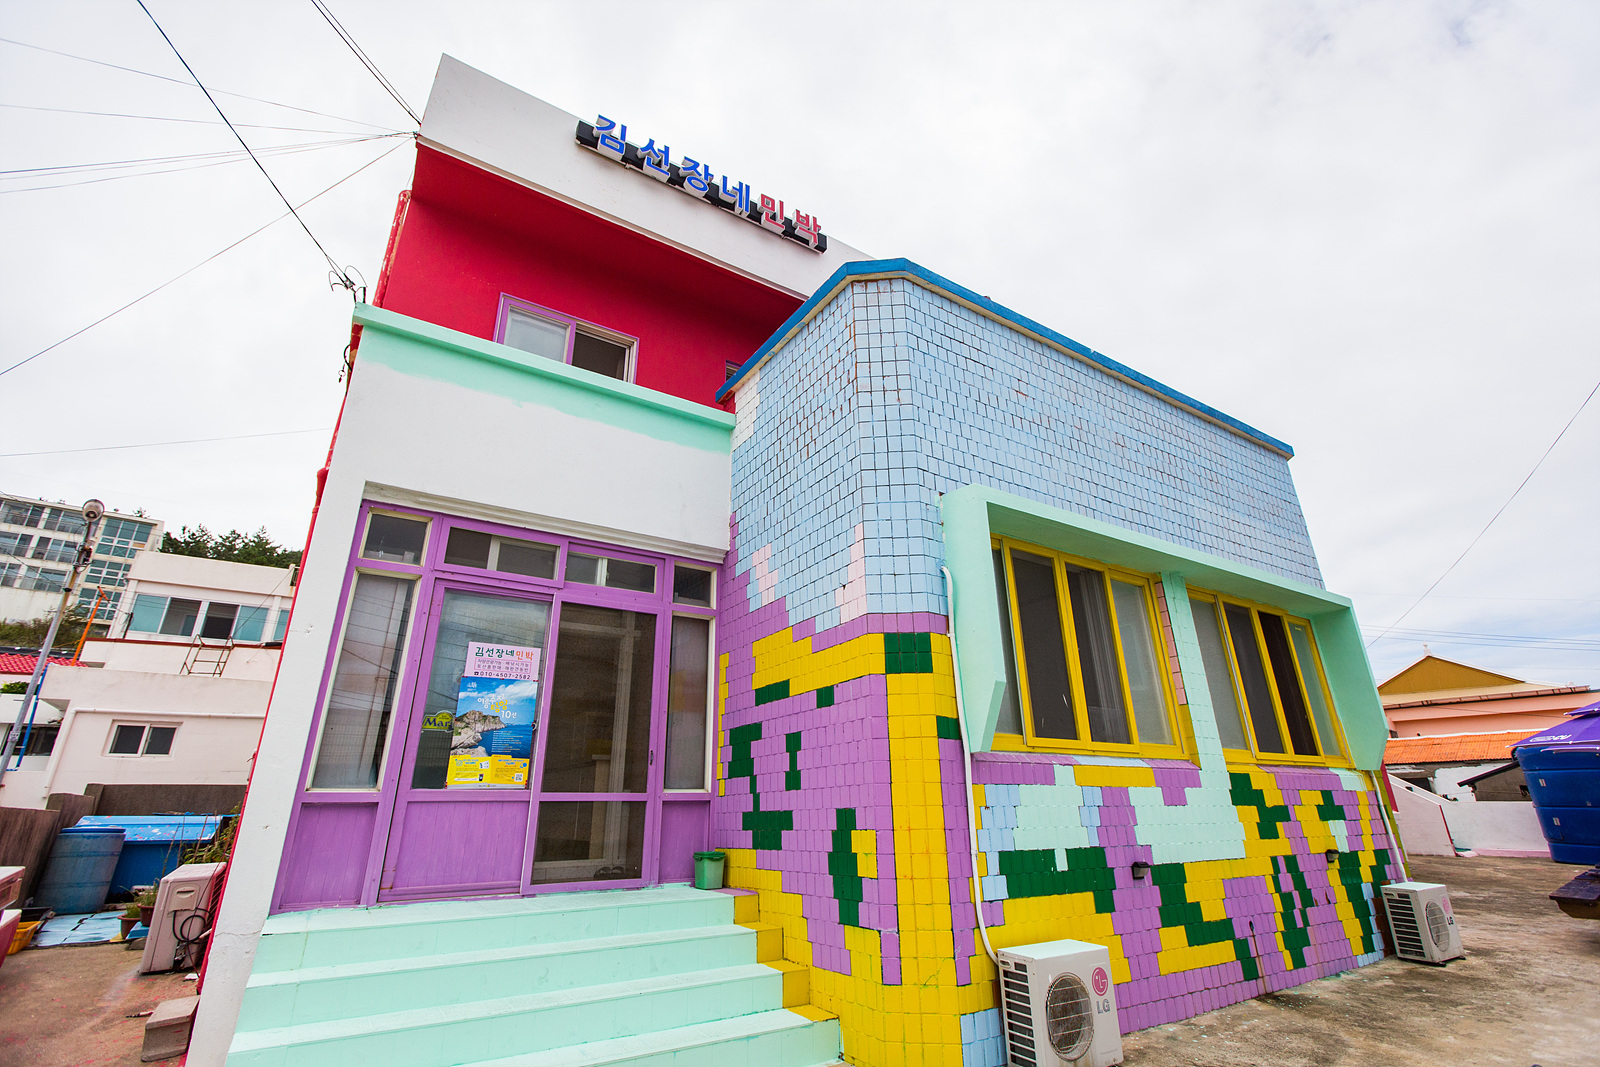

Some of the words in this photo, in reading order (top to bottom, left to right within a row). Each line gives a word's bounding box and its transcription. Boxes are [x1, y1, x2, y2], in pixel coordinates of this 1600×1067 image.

[593, 114, 750, 216] 김선장네
[757, 192, 822, 247] 민박
[475, 646, 515, 659] 김선장네
[515, 650, 535, 661] 민박
[480, 670, 531, 680] 010-4507-2582
[1446, 916, 1455, 926] LG
[1096, 998, 1111, 1015] LG
